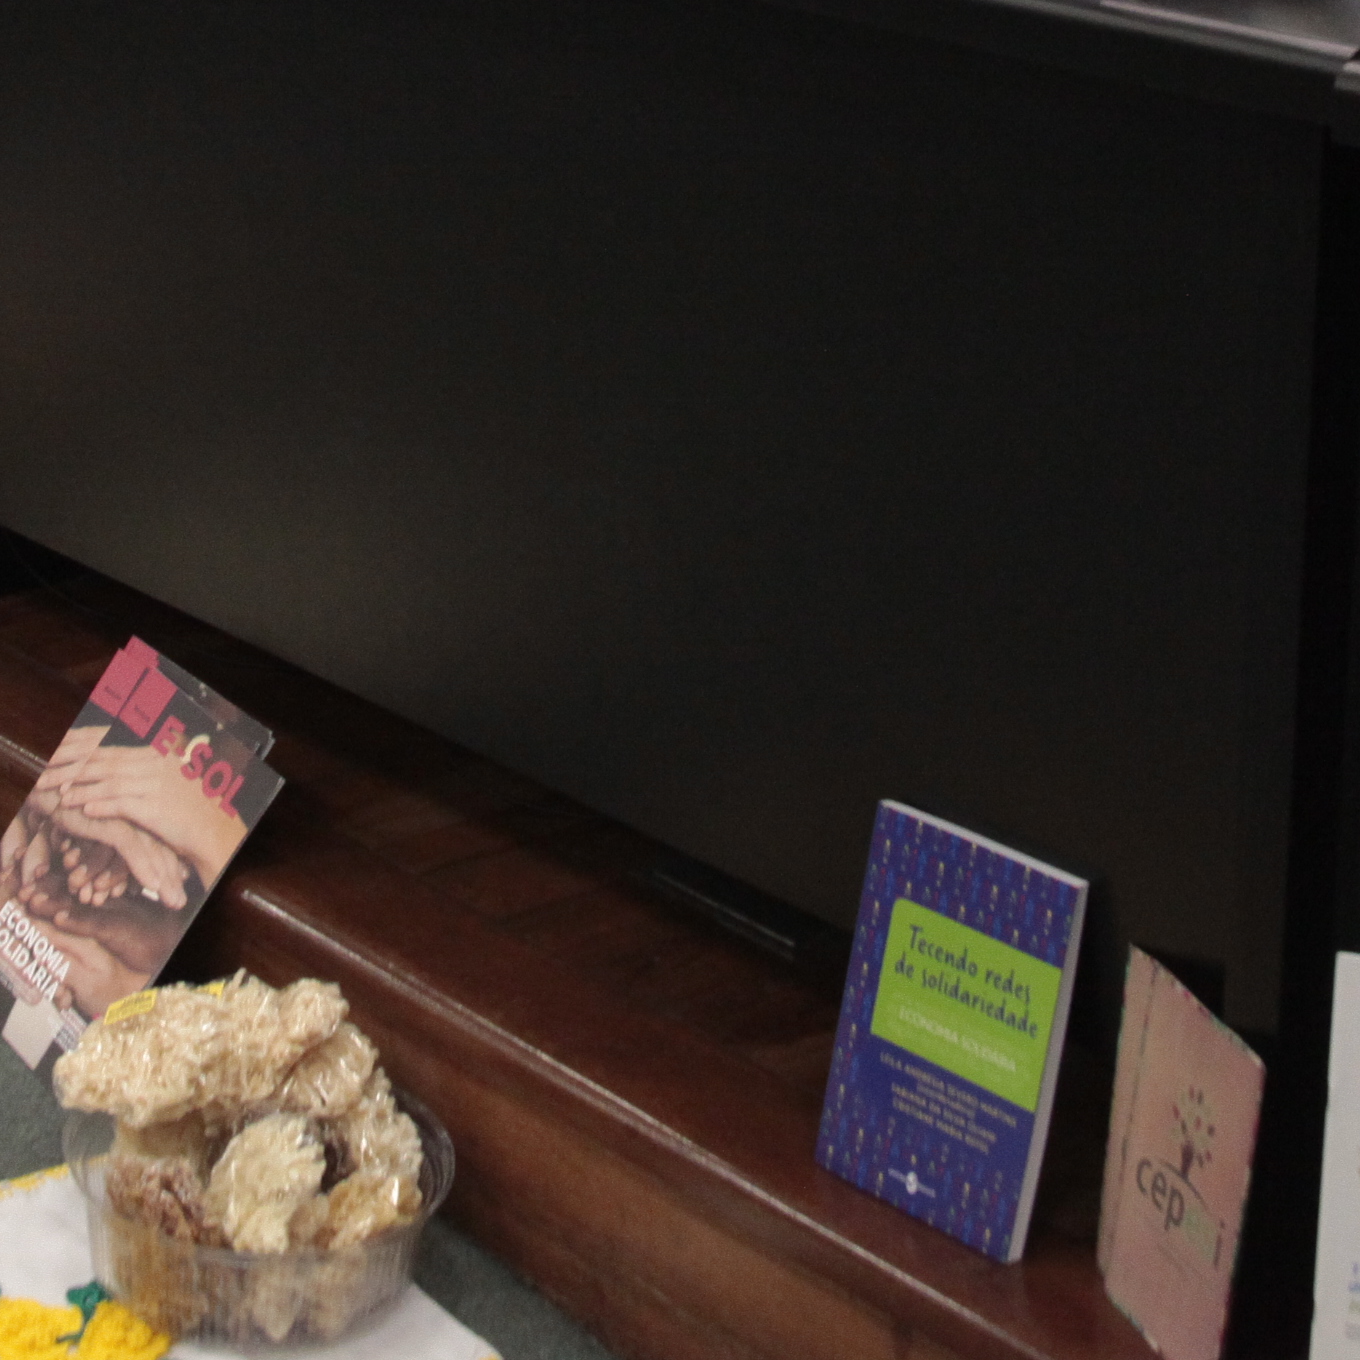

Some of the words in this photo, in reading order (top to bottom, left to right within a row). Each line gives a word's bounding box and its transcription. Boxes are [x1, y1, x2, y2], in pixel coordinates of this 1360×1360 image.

[894, 951, 915, 979] de
[921, 969, 1038, 1039] solidariedade
[910, 924, 978, 978] Tecendo
[985, 969, 1031, 1006] redes
